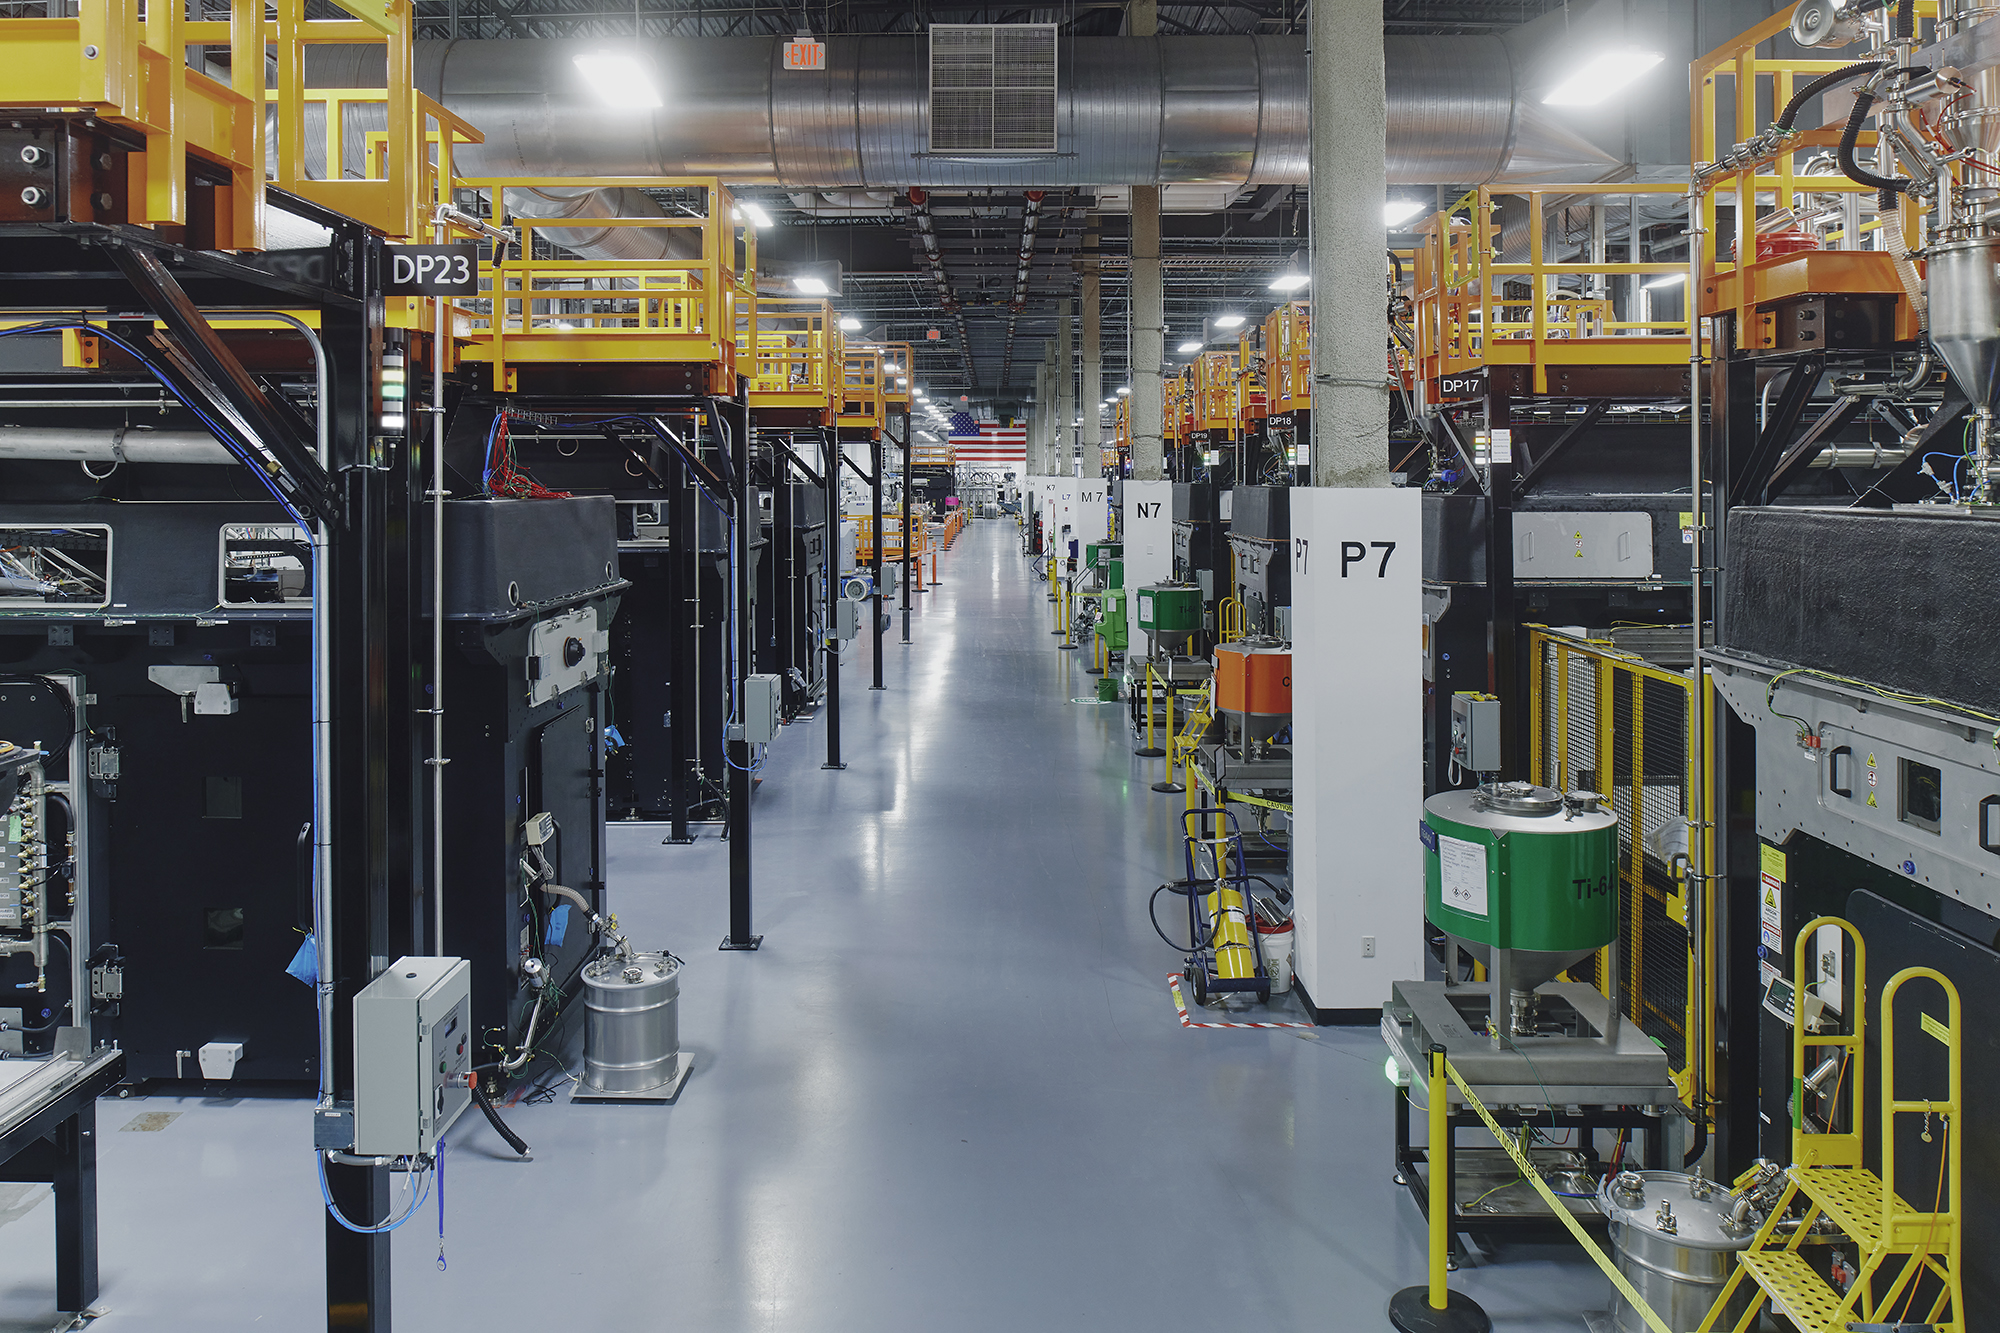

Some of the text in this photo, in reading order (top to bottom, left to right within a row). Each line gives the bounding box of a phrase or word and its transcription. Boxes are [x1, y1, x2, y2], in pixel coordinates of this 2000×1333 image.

[791, 44, 819, 66] EXIT
[393, 254, 470, 284] DP23
[1443, 379, 1479, 392] DP17
[1269, 416, 1291, 425] DP18
[1137, 502, 1161, 518] N7
[1295, 537, 1308, 575] P7
[1341, 541, 1396, 578] P7
[1572, 873, 1614, 900] Ti-64
[1463, 1084, 1486, 1120] CAUTION
[1501, 1132, 1515, 1156] NOT
[1516, 1150, 1536, 1184] ENTER
